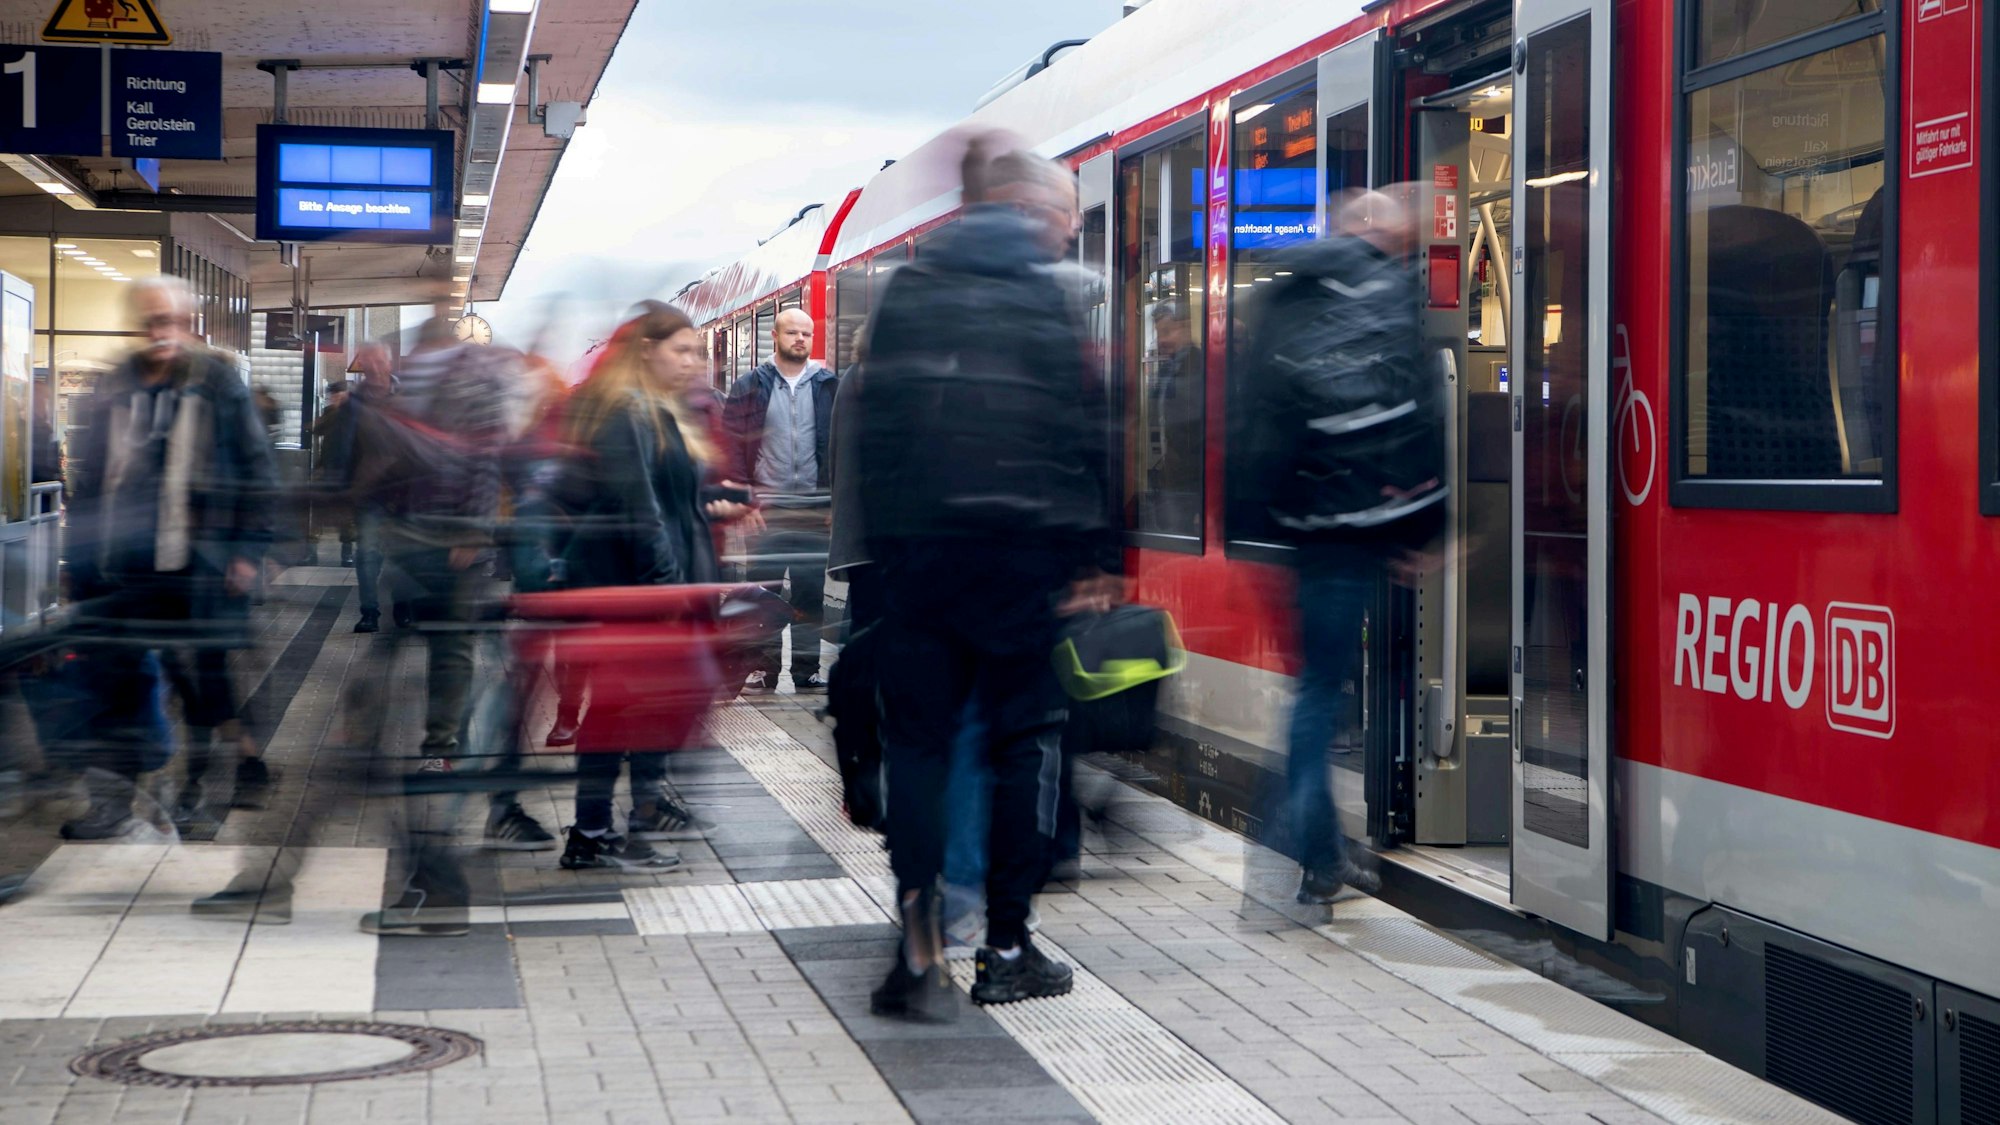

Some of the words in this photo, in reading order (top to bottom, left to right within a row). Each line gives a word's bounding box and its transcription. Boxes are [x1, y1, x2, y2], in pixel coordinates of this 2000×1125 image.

[4, 51, 37, 129] 1
[126, 77, 186, 94] Richtung
[126, 101, 154, 115] Kall
[126, 117, 196, 132] Gerolstein
[1916, 129, 1939, 146] Mitfahrt
[1940, 128, 1950, 140] nur
[1950, 123, 1961, 138] mit
[126, 133, 158, 147] Trier
[1939, 140, 1967, 157] Fahrkarte
[1213, 119, 1225, 190] 2
[299, 200, 323, 212] Bitte
[326, 201, 364, 215] Ansage
[365, 202, 411, 214] beachten
[327, 317, 340, 345] 1
[1673, 592, 1815, 709] REGIO
[1835, 625, 1886, 712] DB
